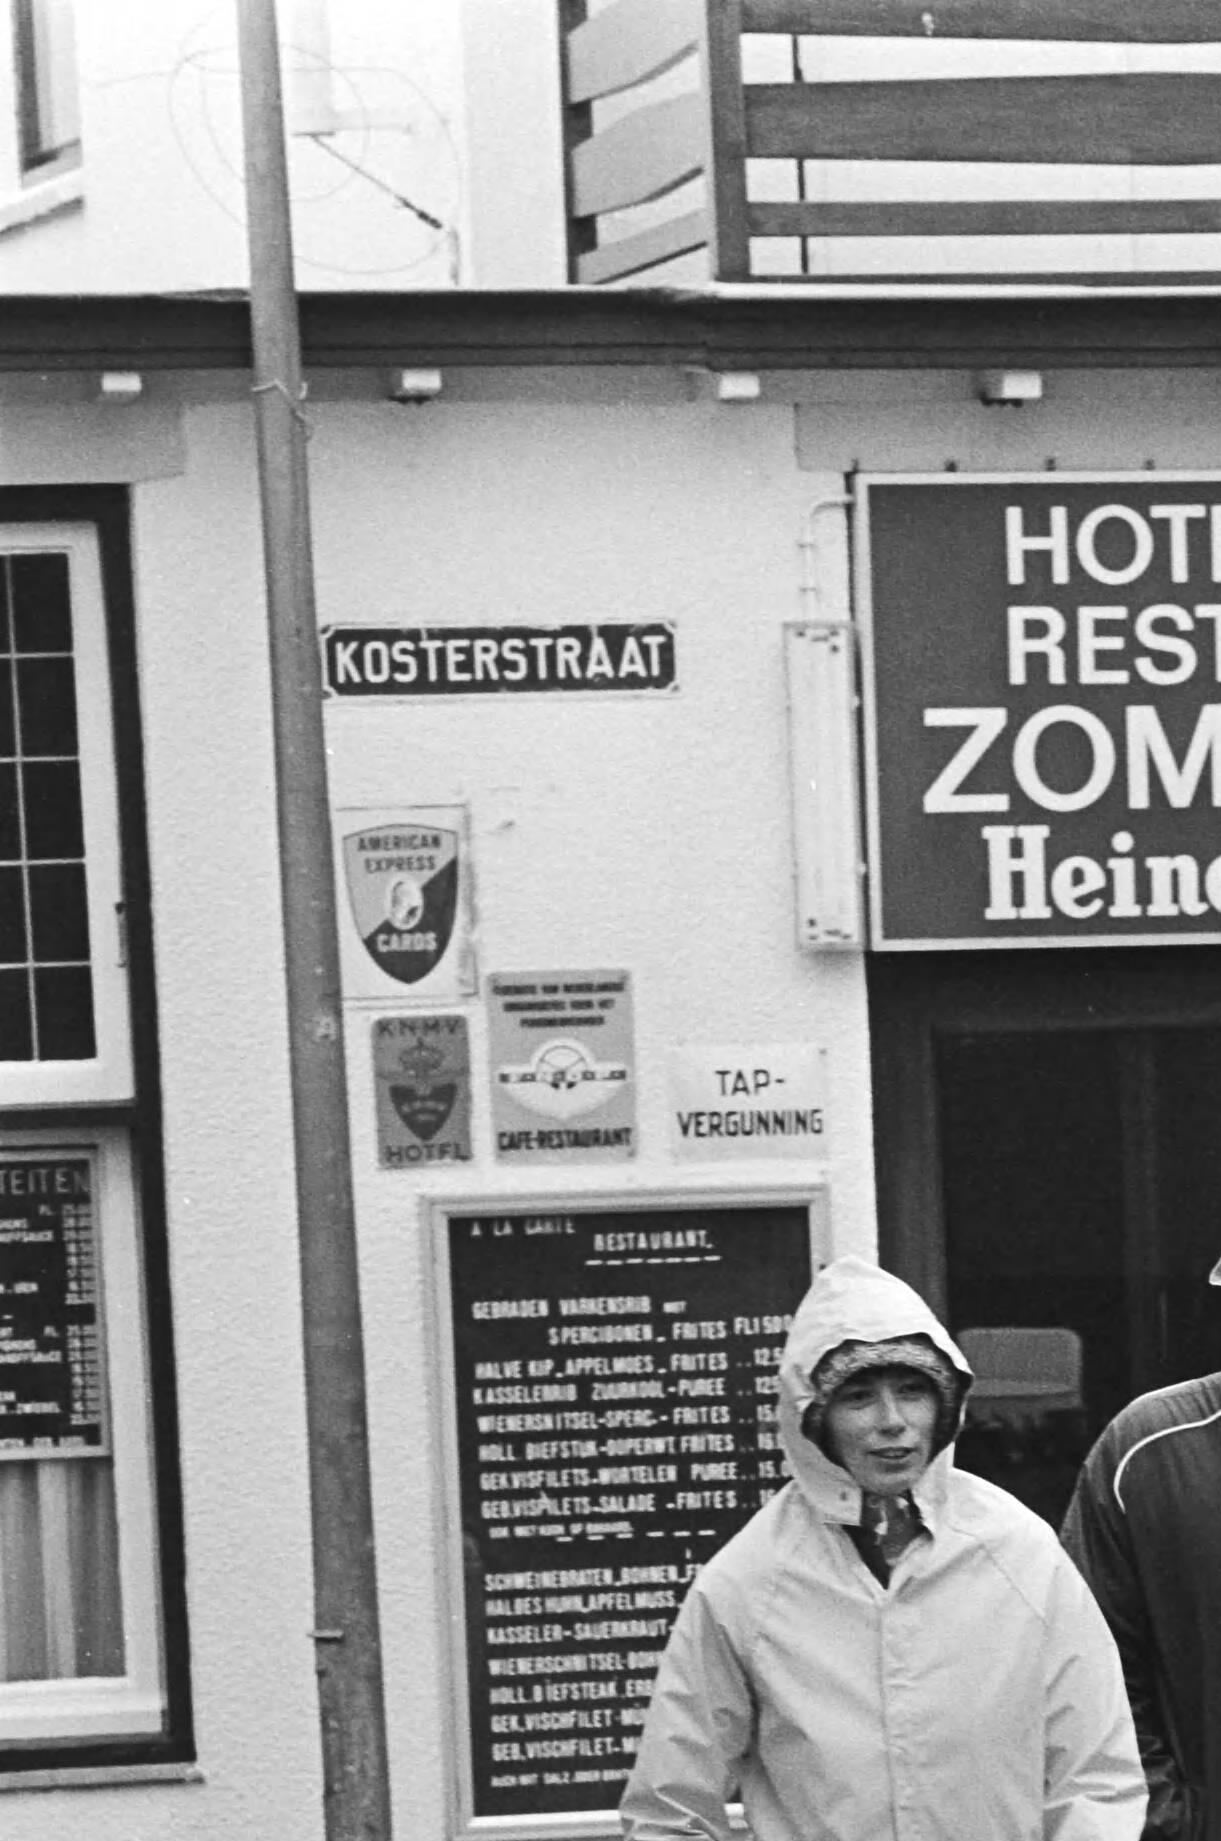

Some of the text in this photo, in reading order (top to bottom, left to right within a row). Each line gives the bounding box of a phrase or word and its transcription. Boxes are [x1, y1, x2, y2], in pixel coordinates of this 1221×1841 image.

[335, 635, 666, 683] KOSTERSTRAAT
[358, 834, 441, 851] AMERICAN
[364, 857, 436, 873] EXPRESS
[376, 931, 437, 953] CARDS
[715, 1069, 785, 1096] TAP-
[676, 1108, 823, 1137] VERGUNNING
